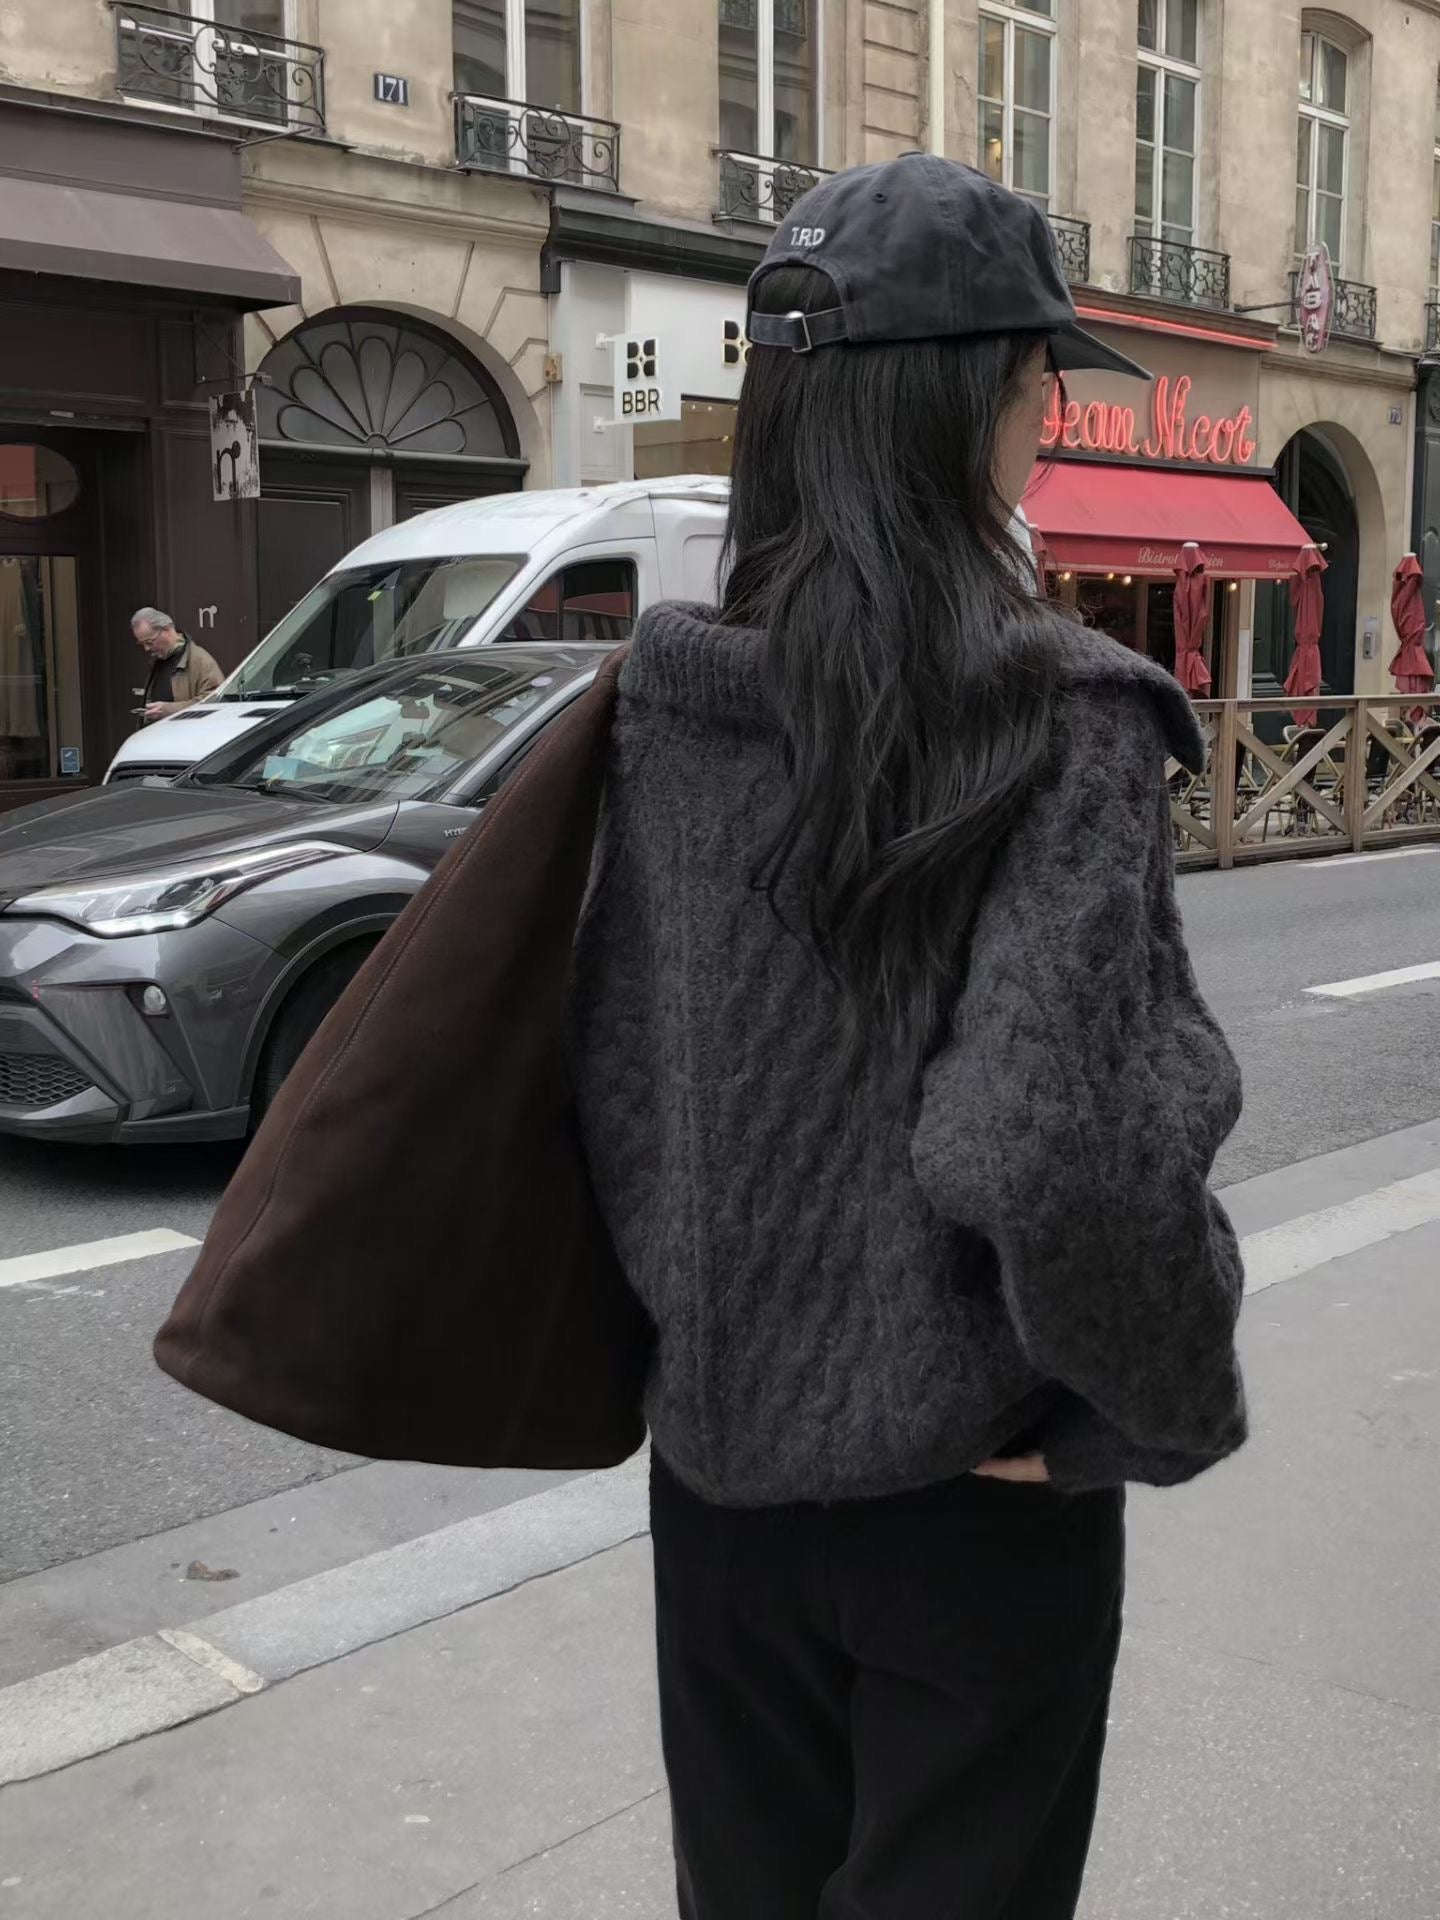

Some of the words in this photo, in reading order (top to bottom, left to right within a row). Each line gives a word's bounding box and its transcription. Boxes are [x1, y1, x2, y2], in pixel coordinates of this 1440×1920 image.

[378, 75, 404, 103] 171
[622, 388, 660, 415] BBR
[1040, 371, 1139, 451] Jean
[1144, 375, 1256, 463] Nicot
